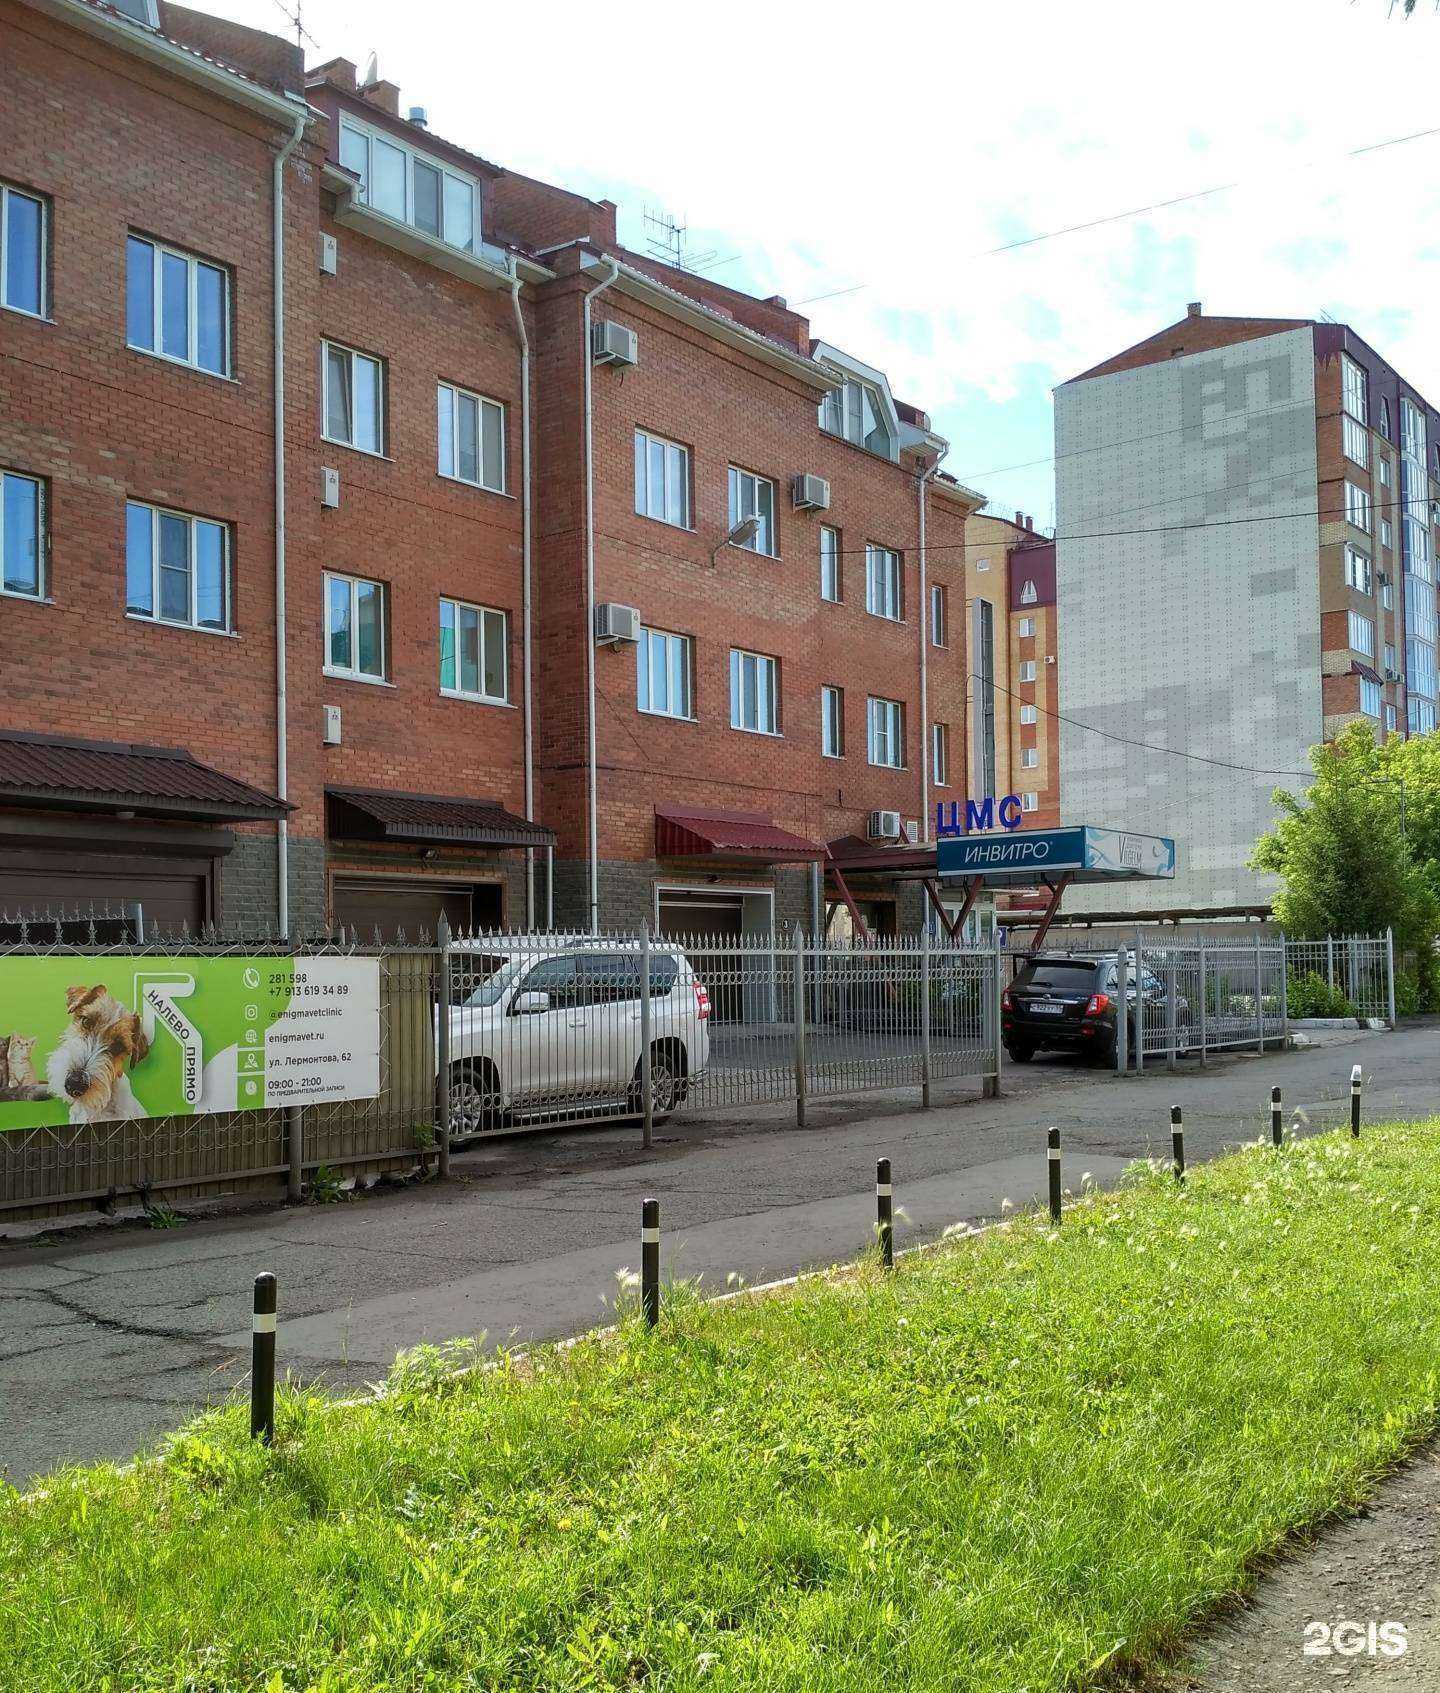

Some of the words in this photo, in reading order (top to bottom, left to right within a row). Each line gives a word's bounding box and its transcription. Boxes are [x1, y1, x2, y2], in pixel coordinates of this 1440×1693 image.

[936, 795, 1022, 836] ЦМС
[964, 842, 1049, 863] ИНВИТРО
[269, 973, 286, 984] 281
[289, 973, 307, 983] 598
[269, 986, 281, 997] +7
[285, 986, 301, 997] 913
[304, 985, 320, 996] 619
[322, 985, 334, 995] 34
[337, 984, 349, 995] 89
[147, 989, 190, 1040] НАЛЕВО
[186, 1046, 196, 1101] ПРЯМО
[269, 1032, 325, 1044] enigmavet.ru
[269, 1058, 283, 1068] ул.
[284, 1054, 340, 1067] Лермонтова,
[341, 1052, 352, 1062] 62
[268, 1079, 294, 1090] 09:00
[301, 1076, 322, 1087] 21:00
